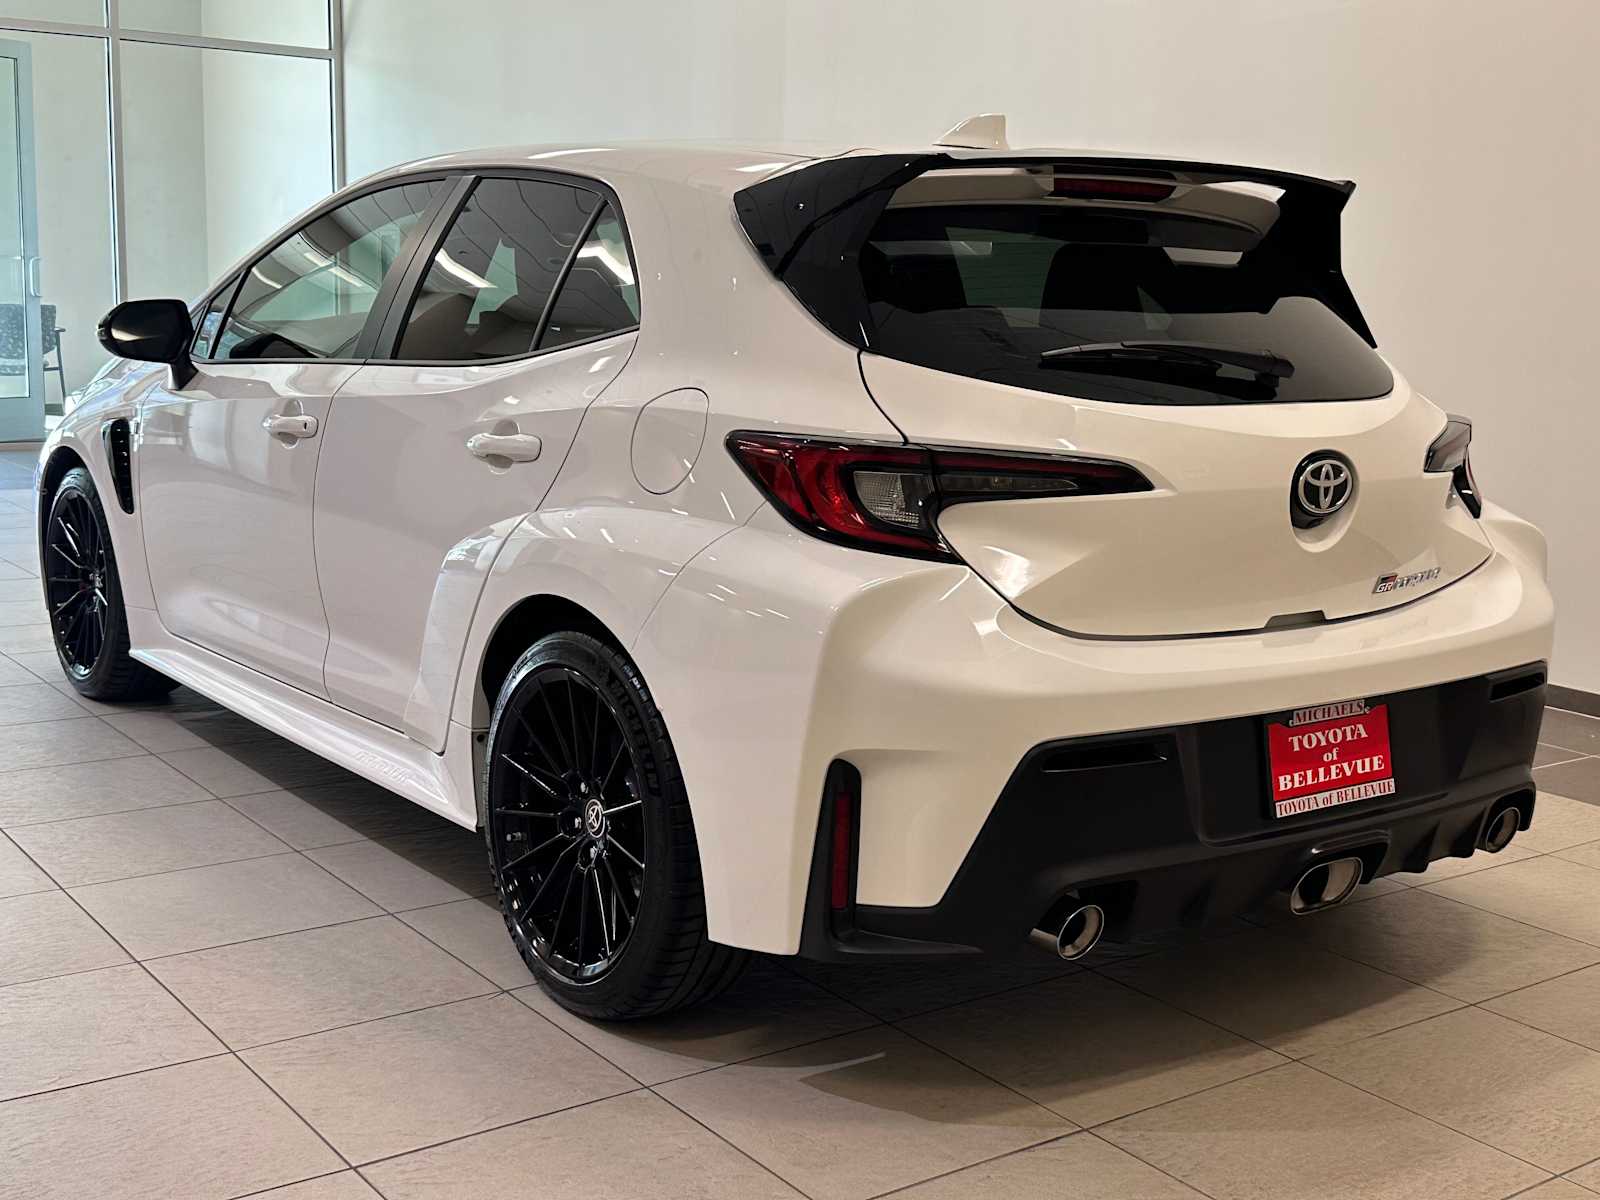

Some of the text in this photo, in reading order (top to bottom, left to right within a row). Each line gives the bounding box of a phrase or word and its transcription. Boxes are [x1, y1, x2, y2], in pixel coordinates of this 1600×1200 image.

[1295, 701, 1363, 724] MICHAELS
[1288, 724, 1368, 752] TOYOTA
[1323, 747, 1339, 762] of
[1278, 755, 1385, 791] BELLEVUE
[1278, 781, 1393, 816] TOYOTA of BELLEVUE
